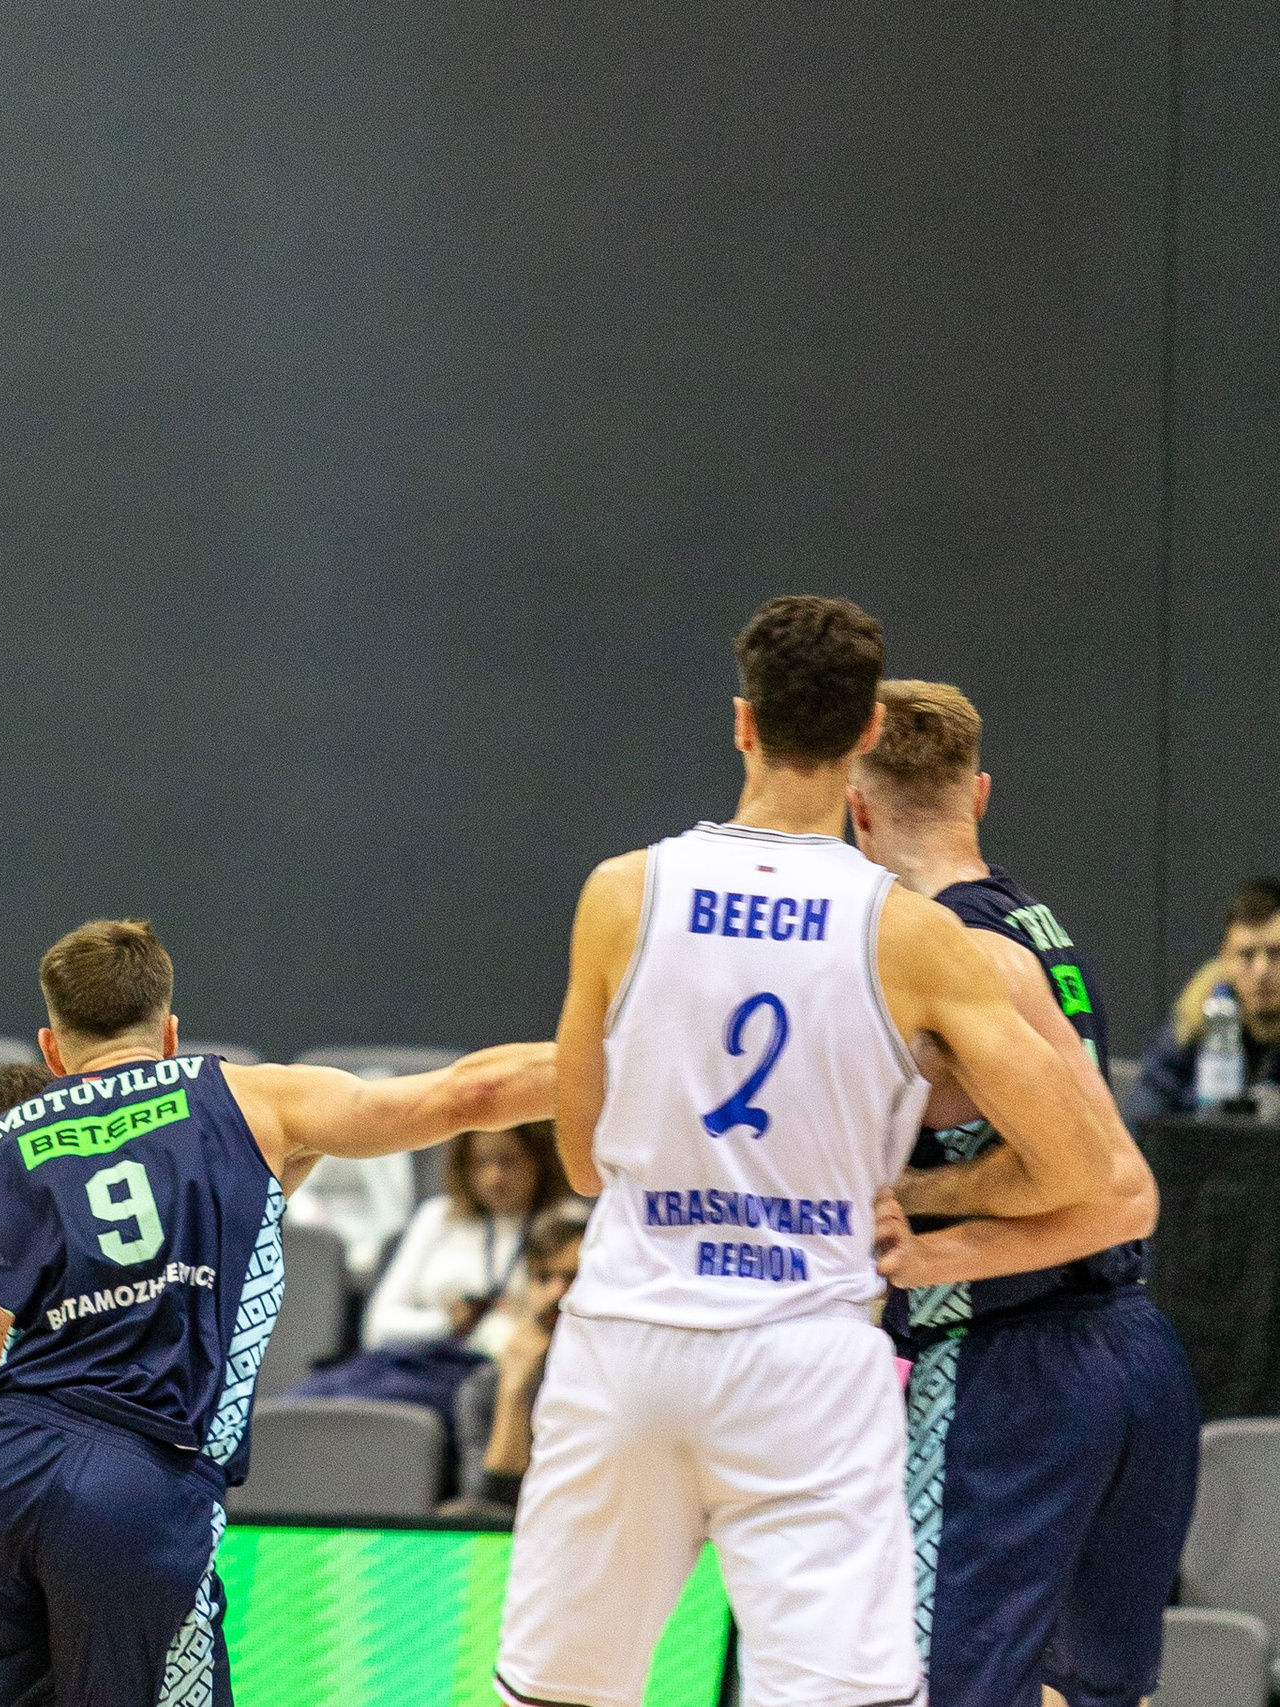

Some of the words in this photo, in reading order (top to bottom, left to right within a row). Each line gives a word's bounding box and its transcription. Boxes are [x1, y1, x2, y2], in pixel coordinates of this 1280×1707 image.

[688, 888, 832, 942] BEECH
[701, 992, 791, 1140] 2
[85, 1159, 165, 1267] 9
[695, 1241, 808, 1282] REGION
